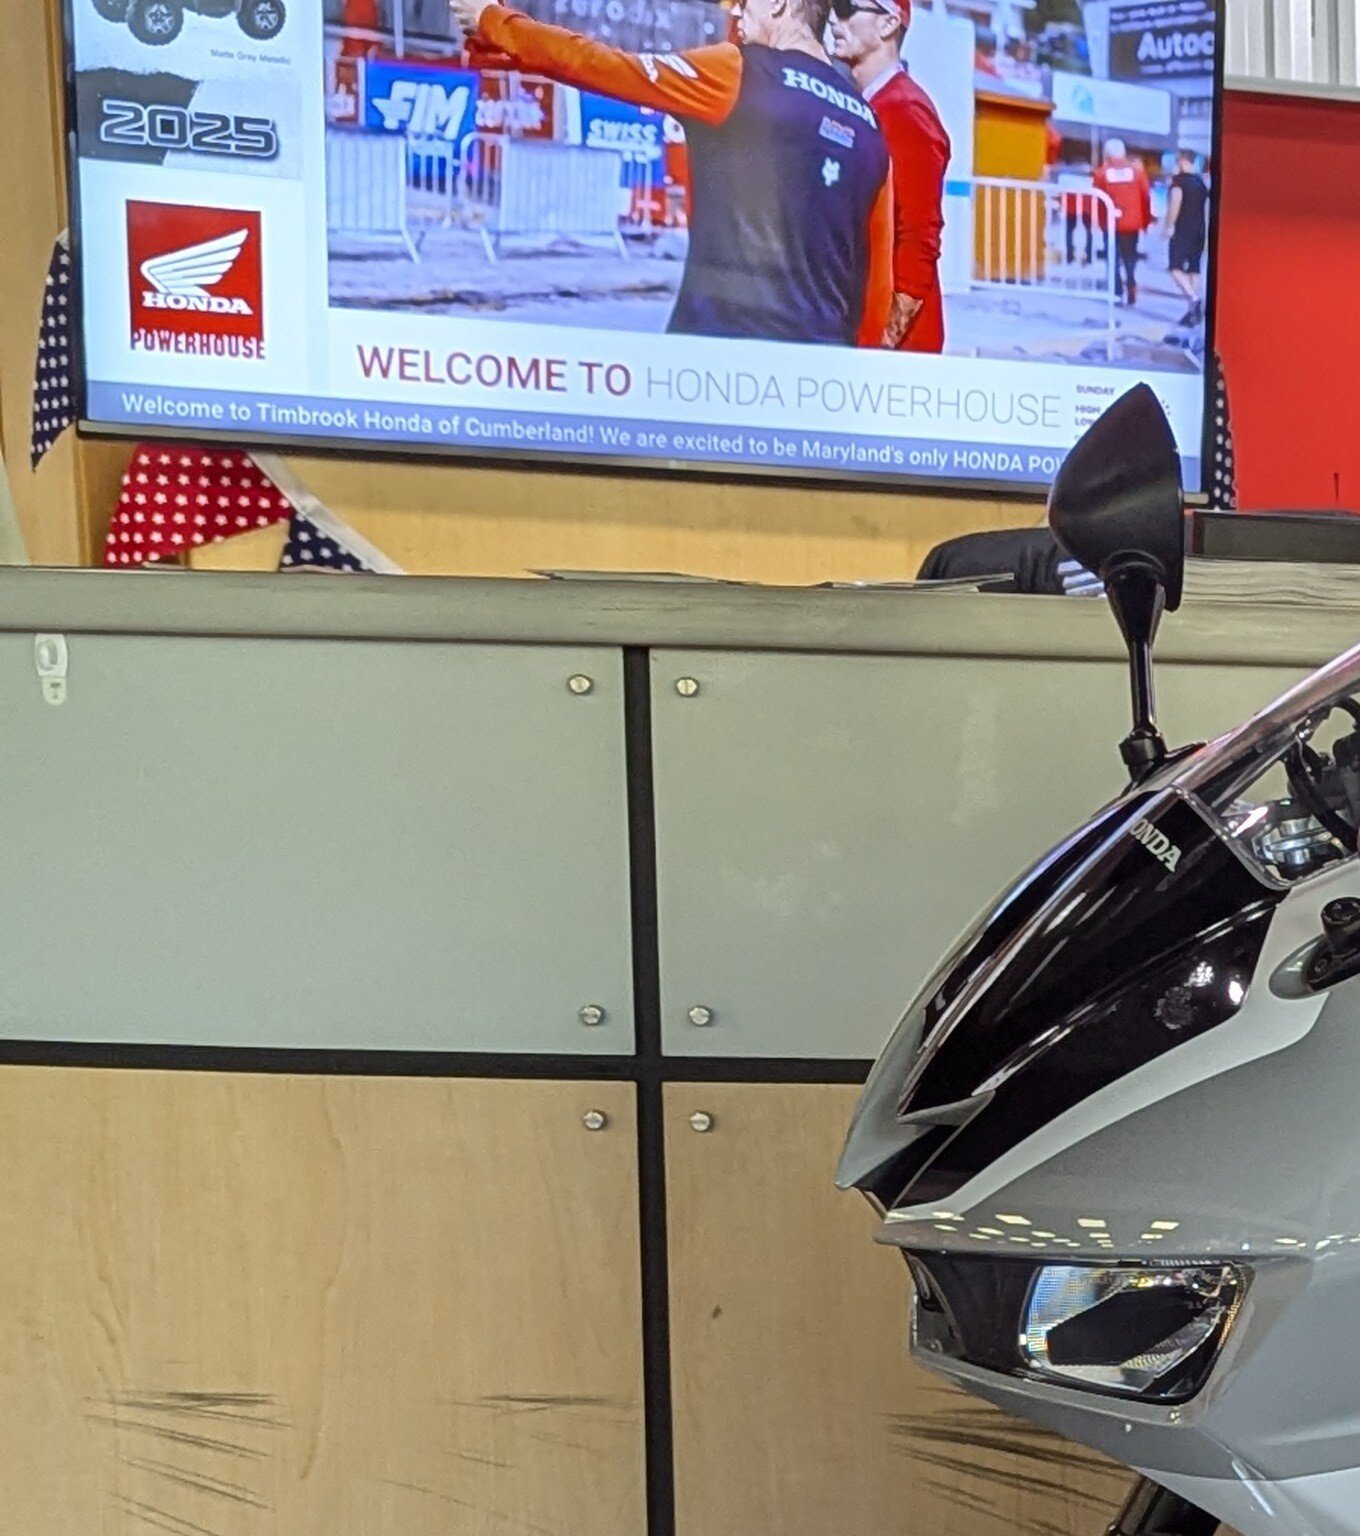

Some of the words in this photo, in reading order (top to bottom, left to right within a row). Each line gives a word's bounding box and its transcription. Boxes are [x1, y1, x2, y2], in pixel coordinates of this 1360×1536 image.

[371, 80, 470, 141] FIM
[781, 67, 877, 130] HONDA
[100, 99, 279, 160] 2025
[588, 118, 658, 148] SWISS
[142, 291, 254, 315] HONDA
[131, 327, 266, 360] POWERHOUSE
[356, 344, 568, 393] WELCOME
[578, 360, 632, 397] TO
[647, 365, 785, 408] HONDA
[797, 376, 1062, 428] POWERHOUSE
[122, 392, 224, 420] Welcome
[230, 401, 251, 421] to
[257, 402, 360, 429] Timbrook
[364, 410, 432, 435] Honda
[440, 414, 459, 436] of
[465, 415, 594, 443] Cumberland!
[599, 425, 631, 447] We
[636, 433, 667, 451] are
[673, 432, 743, 456] excited
[749, 437, 768, 455] to
[773, 437, 797, 457] be
[802, 440, 904, 469] Maryland's
[909, 447, 949, 472] only
[953, 450, 1023, 473] HONDA
